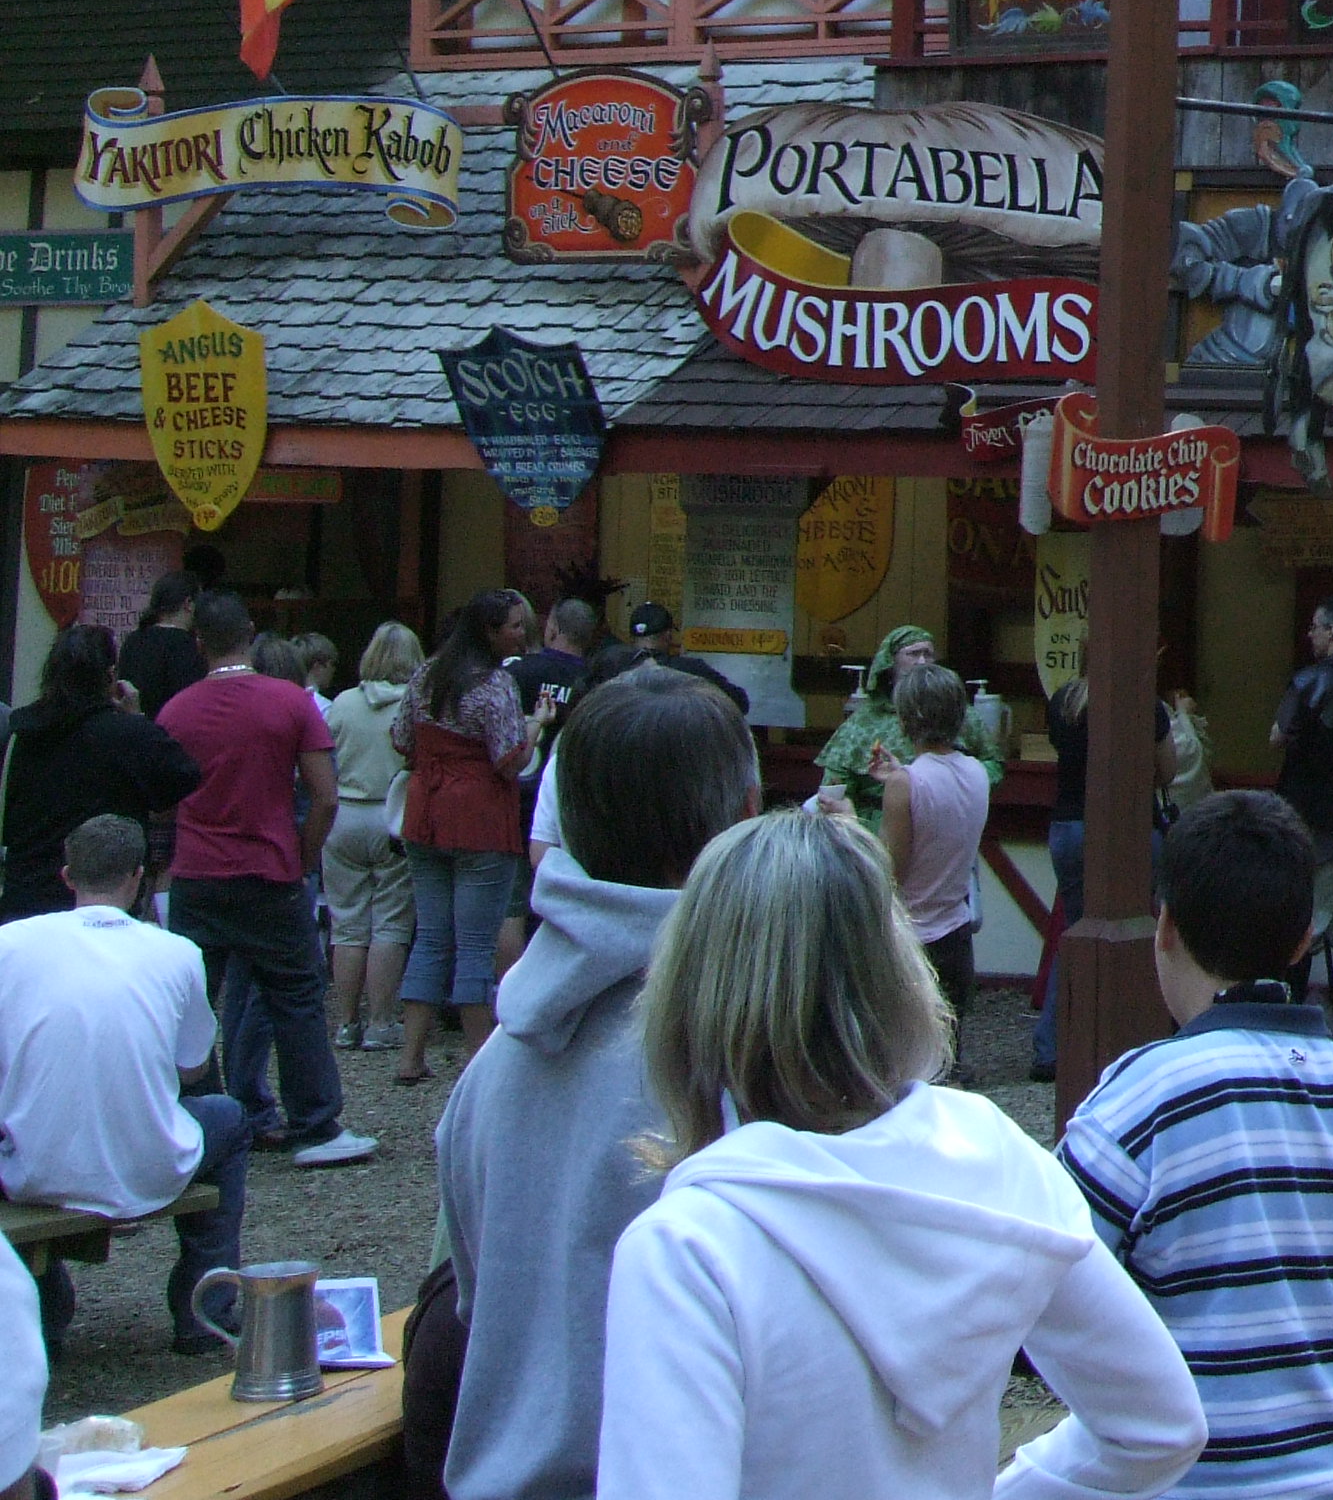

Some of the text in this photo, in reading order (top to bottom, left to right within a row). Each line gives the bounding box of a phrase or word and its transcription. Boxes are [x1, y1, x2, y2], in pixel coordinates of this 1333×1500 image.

[533, 100, 656, 158] Macaroni
[84, 102, 453, 190] YAKITORI Chicken Kabob
[533, 156, 683, 192] CHEESE
[529, 196, 561, 219] on a
[541, 203, 598, 236] stick
[28, 241, 120, 274] Drinks
[1, 278, 55, 297] Soothe
[62, 276, 92, 299] Thy
[702, 248, 1093, 377] MUSHROOMS
[158, 331, 245, 365] ANGUS
[165, 372, 238, 404] BEEF
[457, 348, 585, 407] SCOTCH
[153, 406, 248, 432] & CHEESE
[173, 438, 245, 460] STICKS
[1071, 435, 1209, 476] Chocolate Chip
[1083, 468, 1202, 518] Cookies
[798, 519, 877, 545] HEESE
[1036, 563, 1090, 621] Saus
[1049, 632, 1071, 645] ON
[1045, 650, 1077, 670] STI
